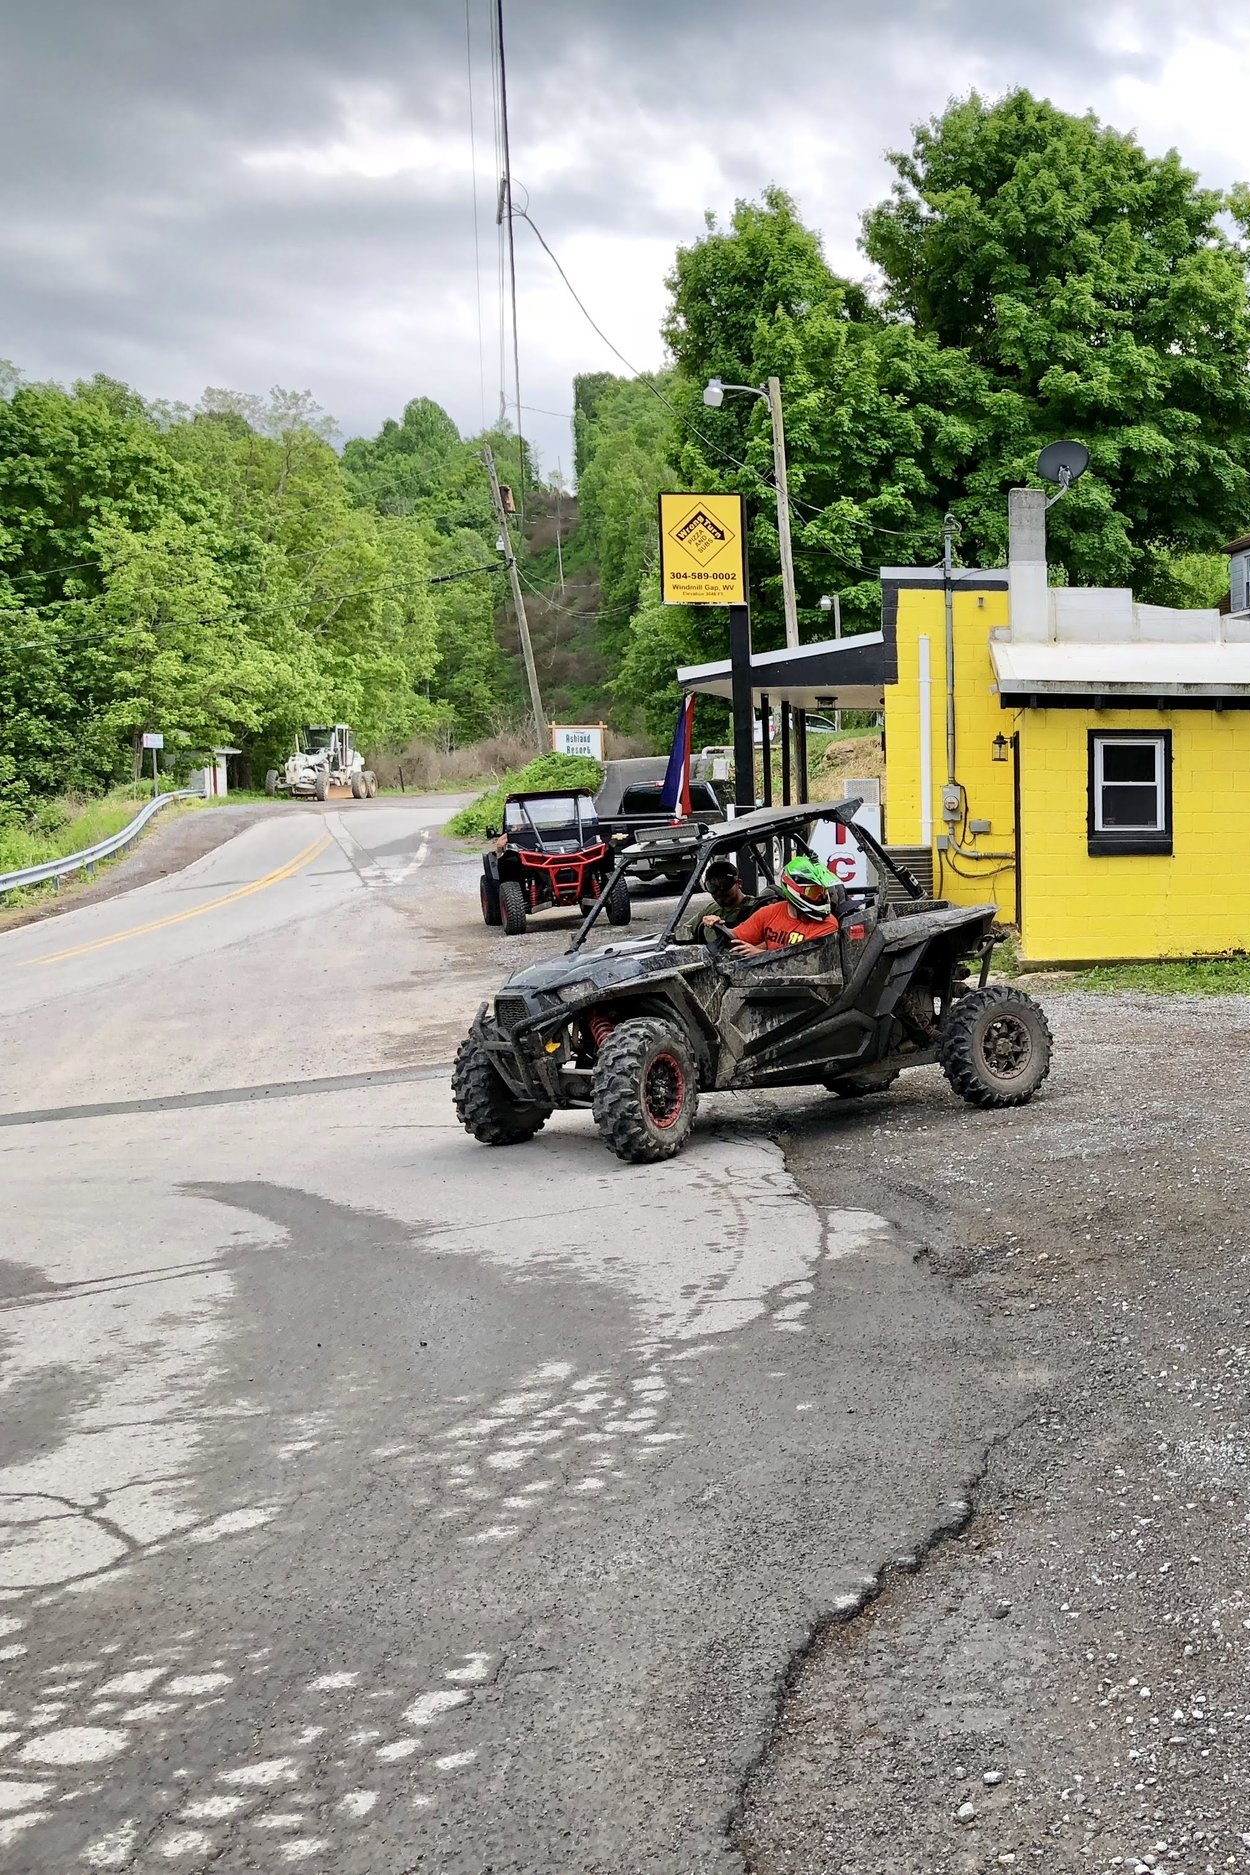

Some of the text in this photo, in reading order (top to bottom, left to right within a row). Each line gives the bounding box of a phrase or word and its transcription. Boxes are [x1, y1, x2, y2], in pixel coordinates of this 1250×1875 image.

[677, 514, 722, 539] Wrong Turn
[687, 529, 705, 545] PIZZA
[695, 534, 708, 548] AND
[697, 538, 714, 553] SUBS
[670, 572, 737, 580] 304-589-0002
[565, 734, 591, 743] Ashland
[566, 746, 591, 754] Resort
